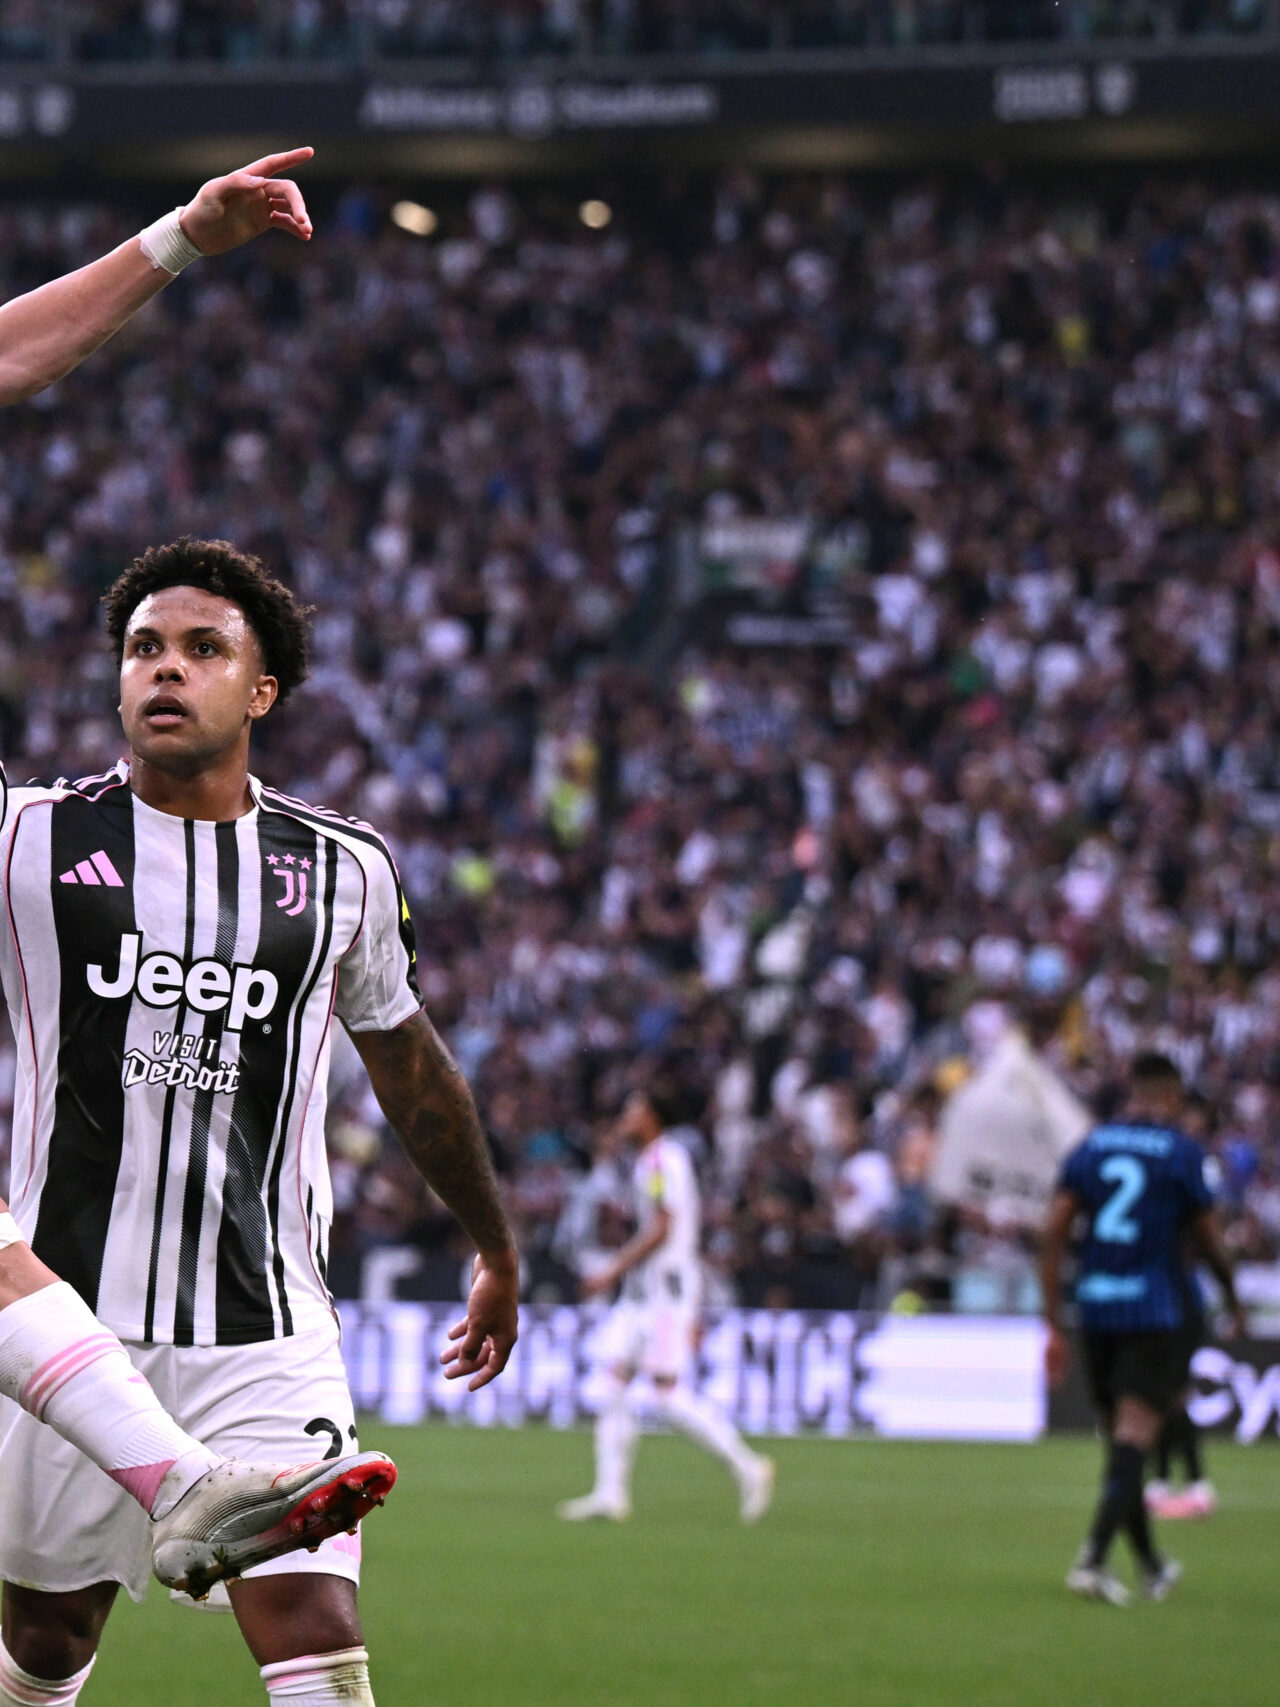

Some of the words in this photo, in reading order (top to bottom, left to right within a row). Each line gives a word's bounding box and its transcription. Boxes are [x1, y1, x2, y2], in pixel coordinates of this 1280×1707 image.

[86, 933, 279, 1030] Jeep
[153, 1031, 218, 1060] VISIT
[124, 1048, 241, 1094] Detroit
[1094, 1154, 1147, 1245] 2
[303, 1417, 358, 1461] 2
